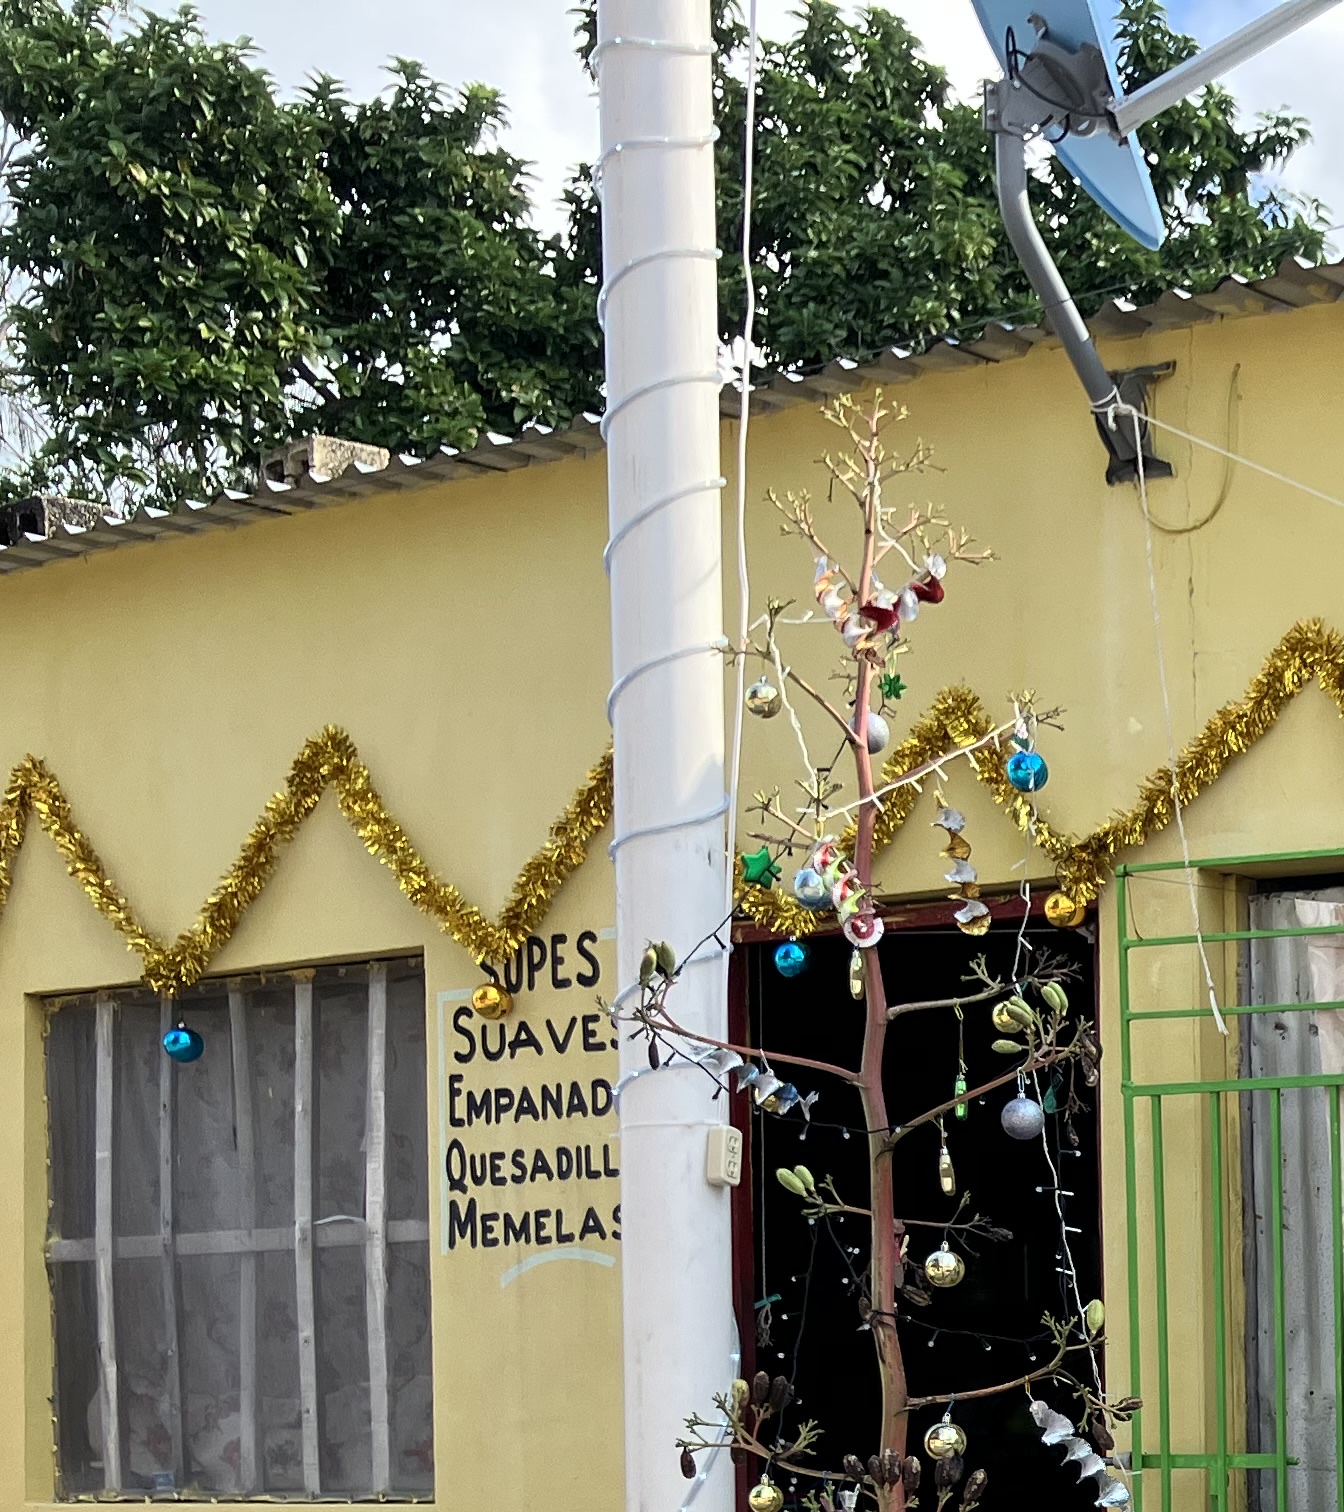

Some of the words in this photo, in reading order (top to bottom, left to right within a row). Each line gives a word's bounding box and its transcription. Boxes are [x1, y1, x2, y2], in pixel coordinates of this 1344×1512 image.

[453, 1006, 619, 1063] SUAVE
[448, 1073, 614, 1127] EMPANAD
[446, 1138, 620, 1193] QUESADILL
